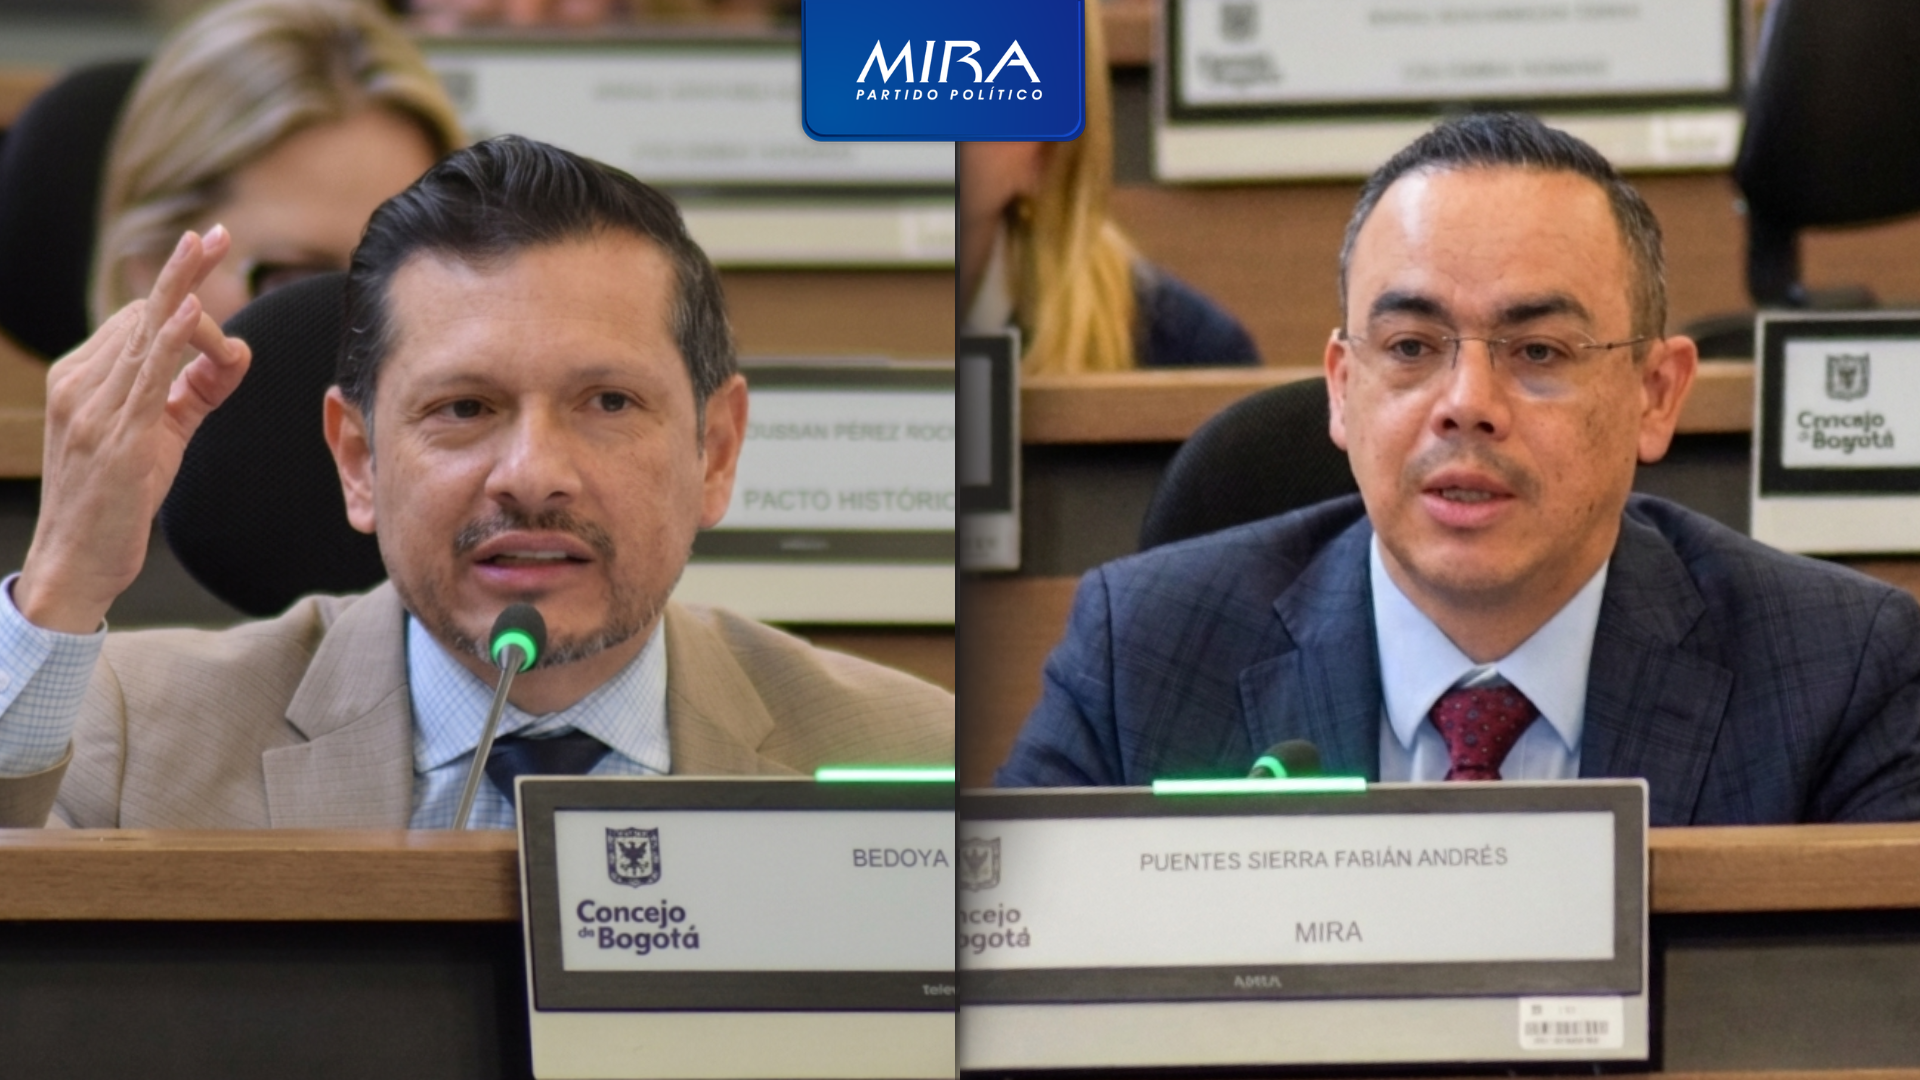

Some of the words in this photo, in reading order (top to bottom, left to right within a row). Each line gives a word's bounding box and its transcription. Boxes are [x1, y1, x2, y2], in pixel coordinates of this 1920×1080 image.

[743, 489, 832, 512] PACTO
[853, 848, 949, 868] BEDOYA
[1140, 852, 1241, 871] PUENTES
[1248, 850, 1328, 869] SIERRA
[1335, 846, 1412, 868] FABIÁN
[1417, 844, 1508, 867] ANDRÉS
[577, 899, 686, 929] Concejo
[598, 925, 699, 955] Bogotá
[1295, 921, 1363, 943] MIRA
